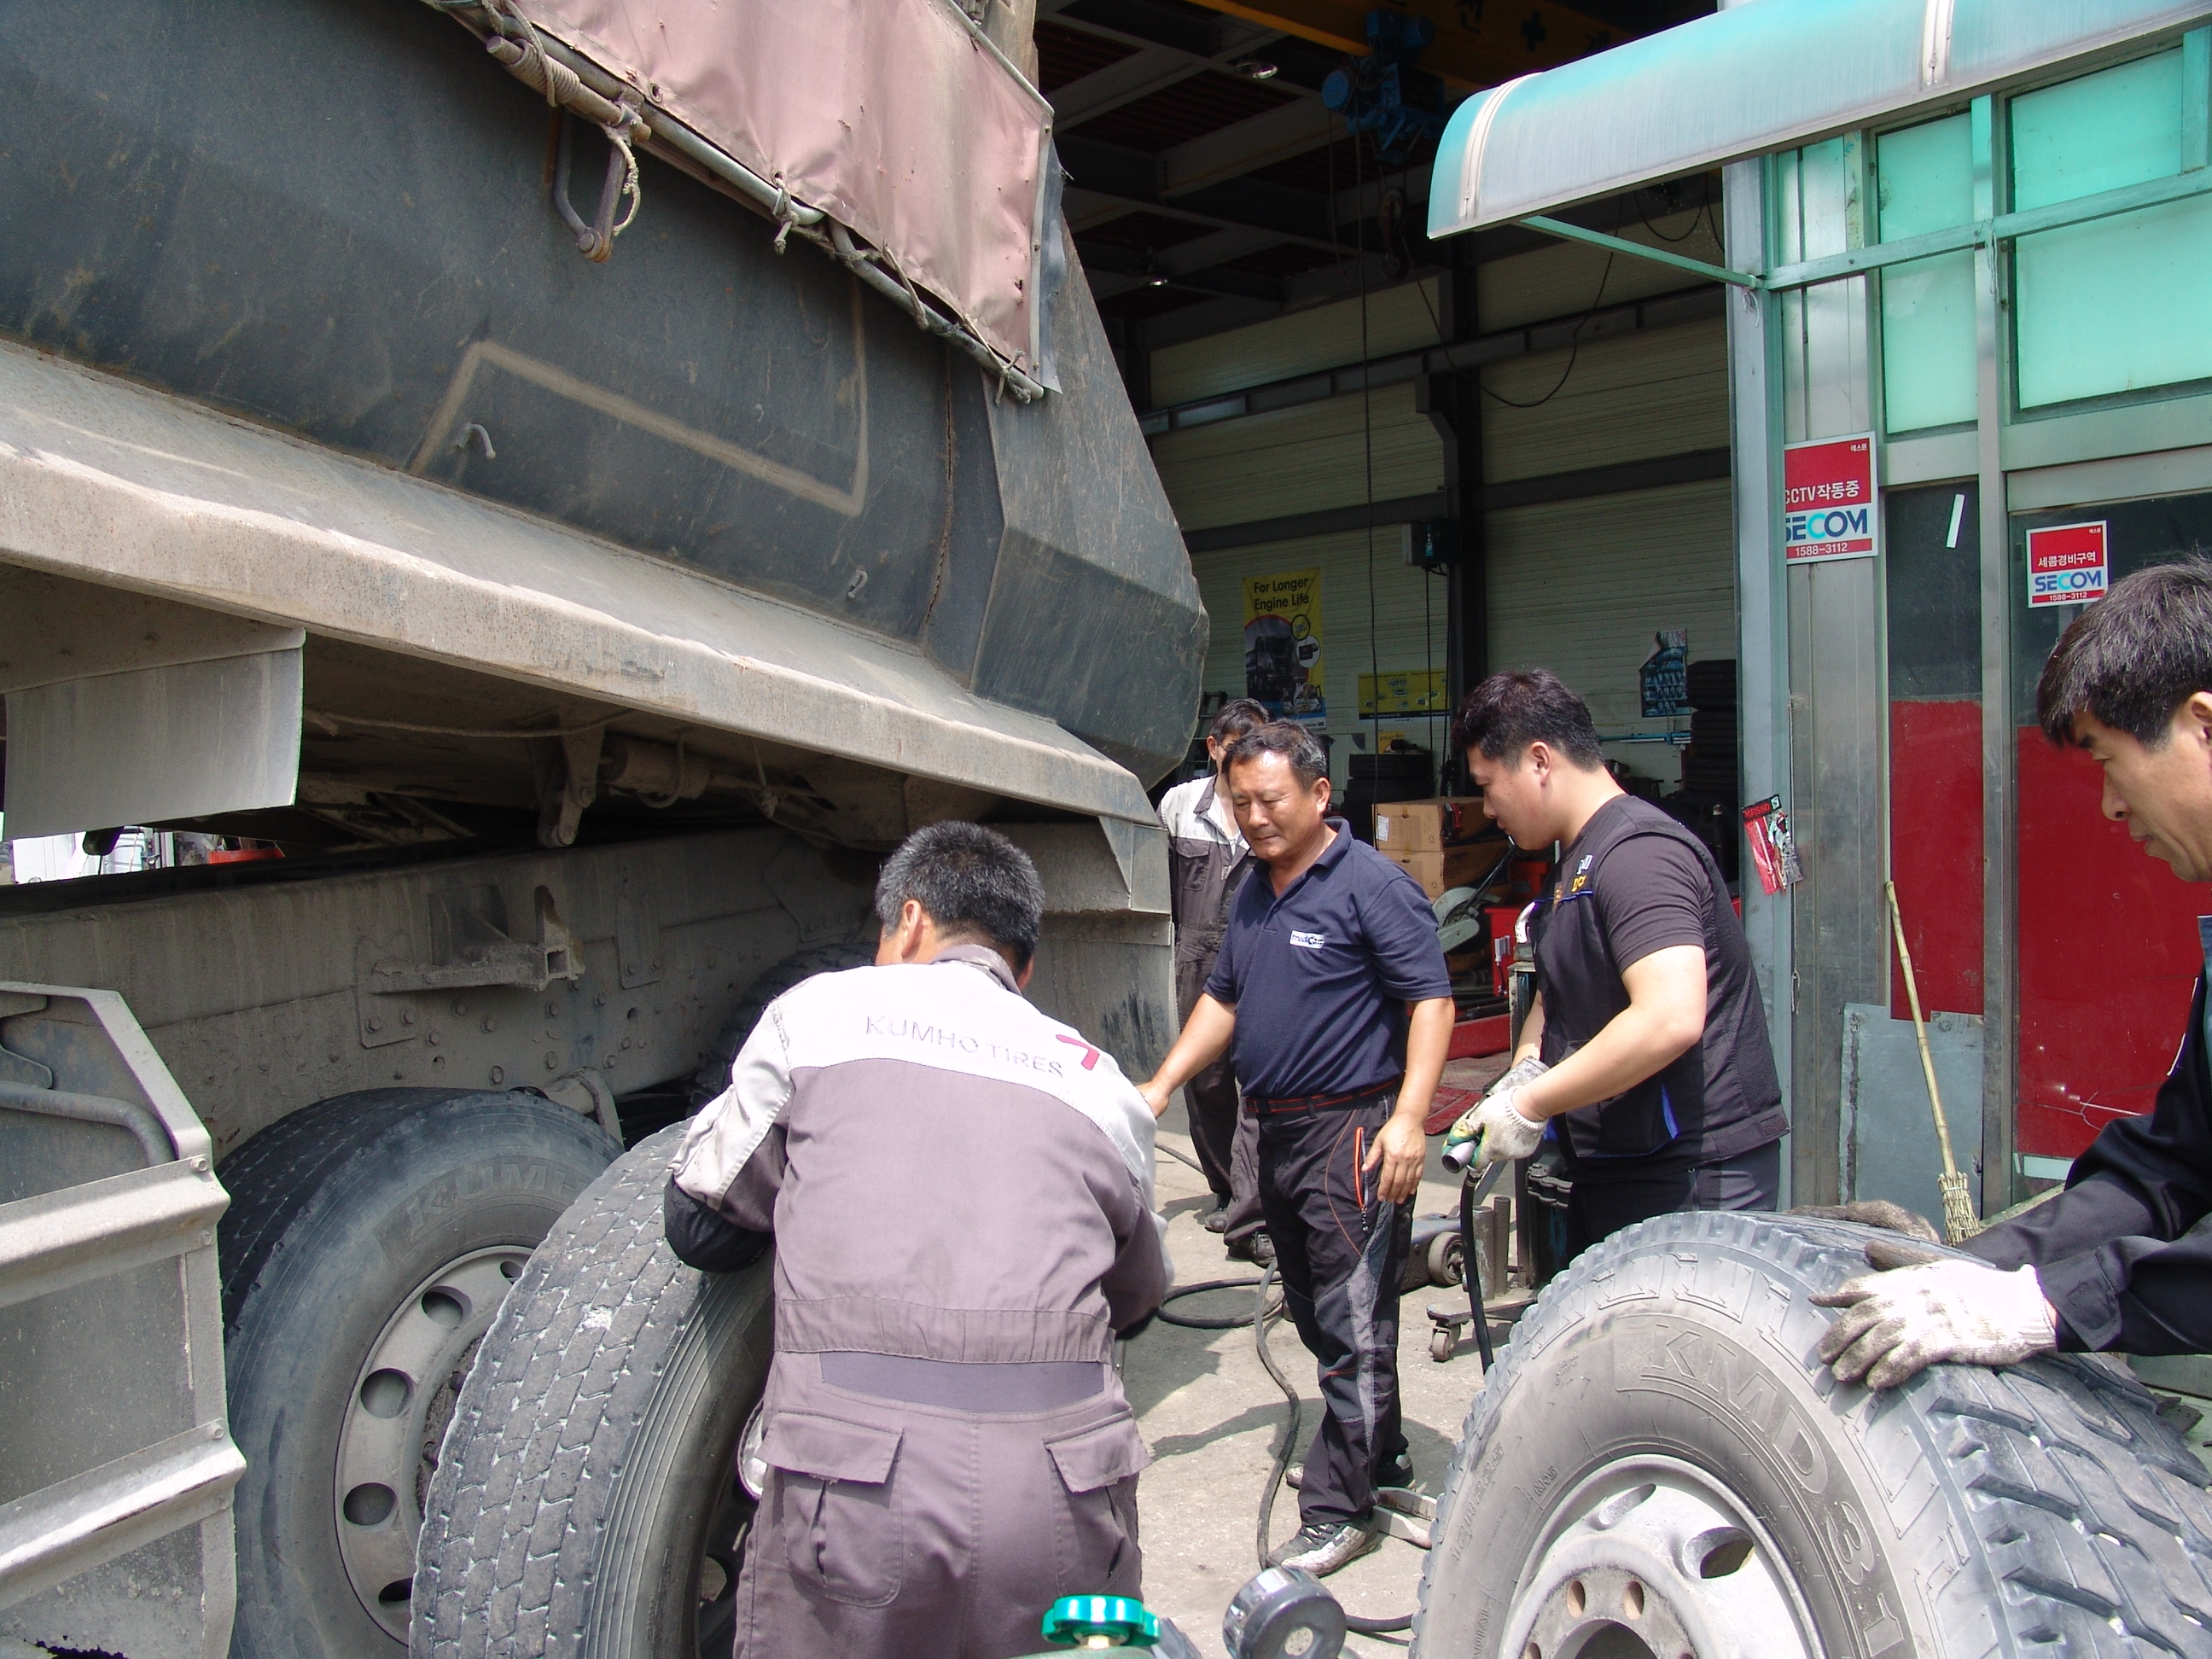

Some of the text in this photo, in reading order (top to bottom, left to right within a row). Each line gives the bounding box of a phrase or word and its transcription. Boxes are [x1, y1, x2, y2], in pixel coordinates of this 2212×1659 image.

[1795, 542, 1848, 557] 1588-3112
[2038, 551, 2096, 568] 세콤경비구역
[1254, 578, 1308, 594] For Longer
[2034, 570, 2102, 592] SECOM
[1254, 593, 1310, 612] Engine Life
[2049, 592, 2088, 601] 1588-3112
[865, 1016, 1064, 1080] KUMHO TIRES
